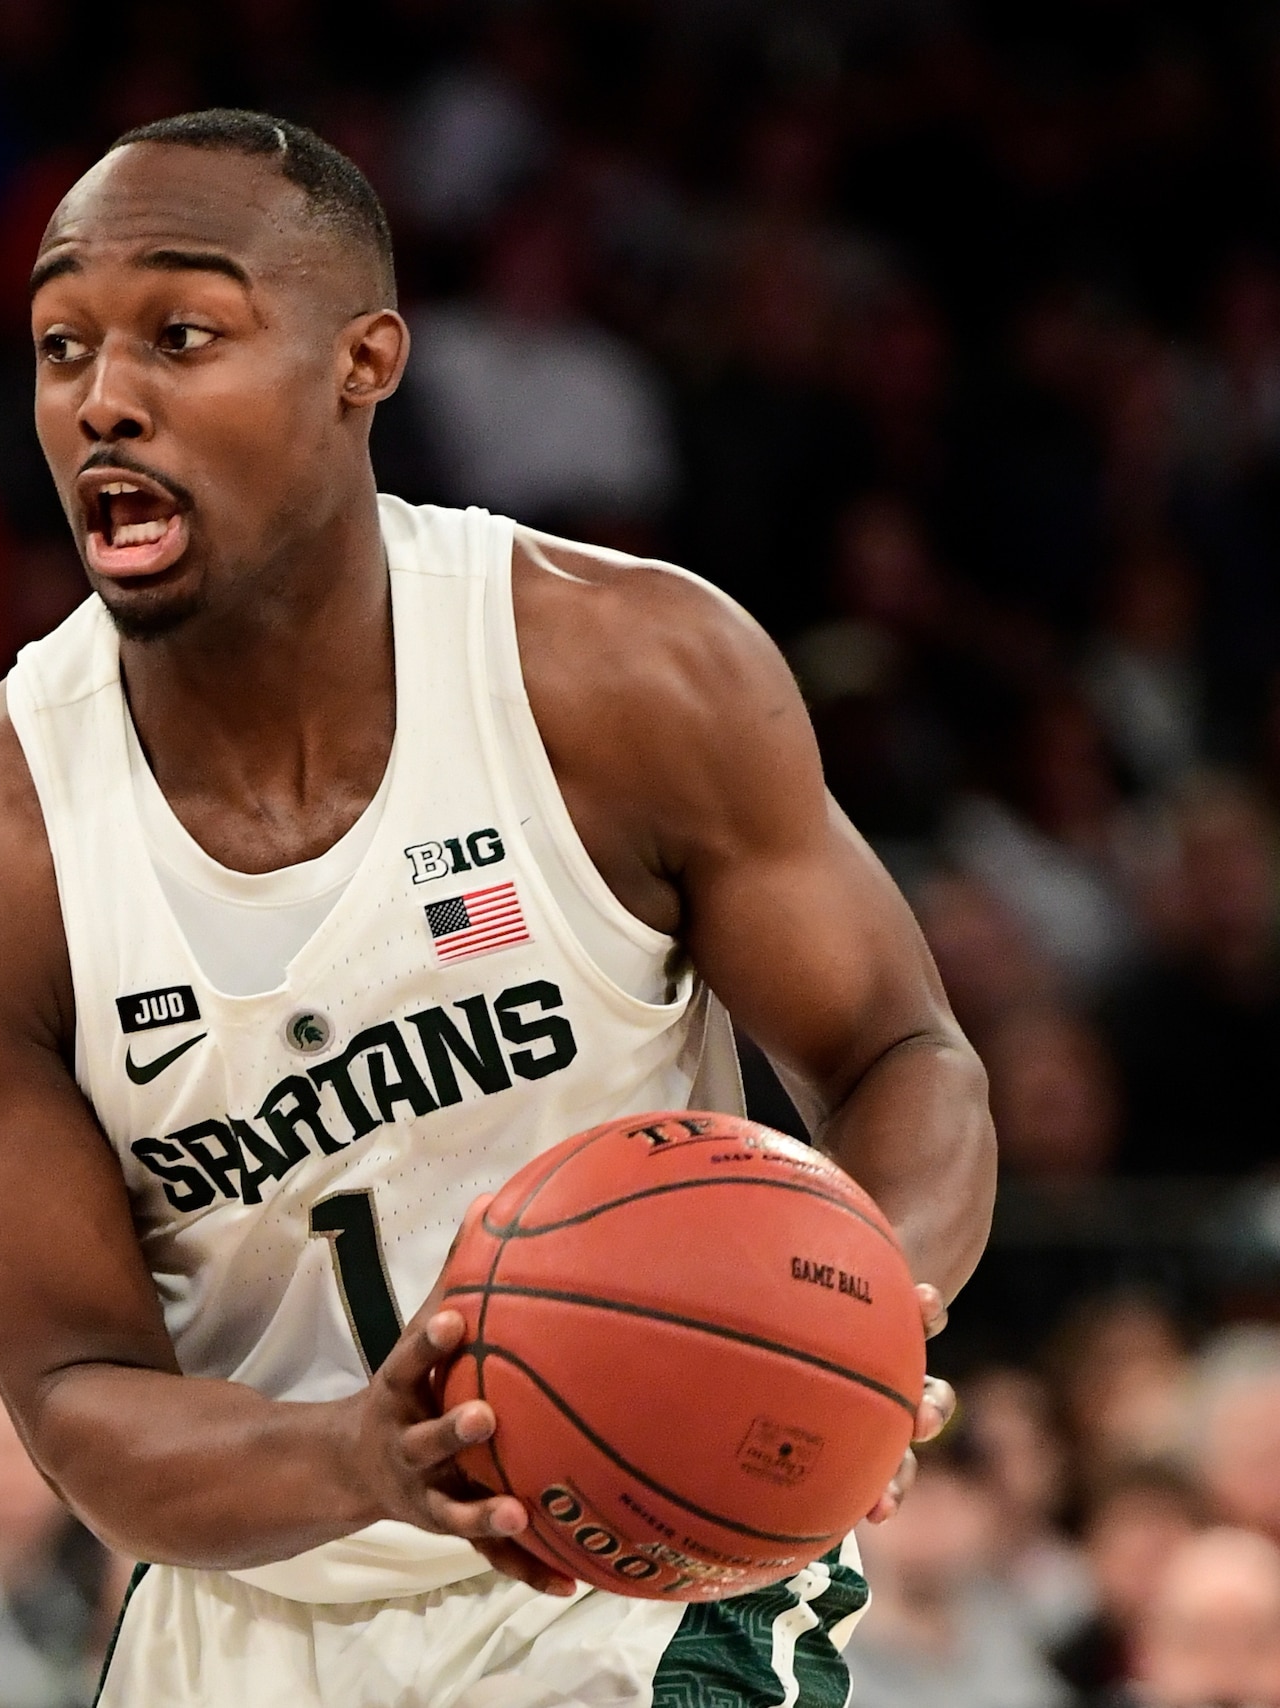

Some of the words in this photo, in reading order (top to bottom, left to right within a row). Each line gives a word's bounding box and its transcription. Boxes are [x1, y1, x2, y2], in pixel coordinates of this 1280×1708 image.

[134, 991, 185, 1025] JUD
[131, 979, 578, 1213] SPARTANS
[308, 1187, 406, 1377] 1
[792, 1256, 835, 1289] GAME
[838, 1270, 873, 1305] BALL
